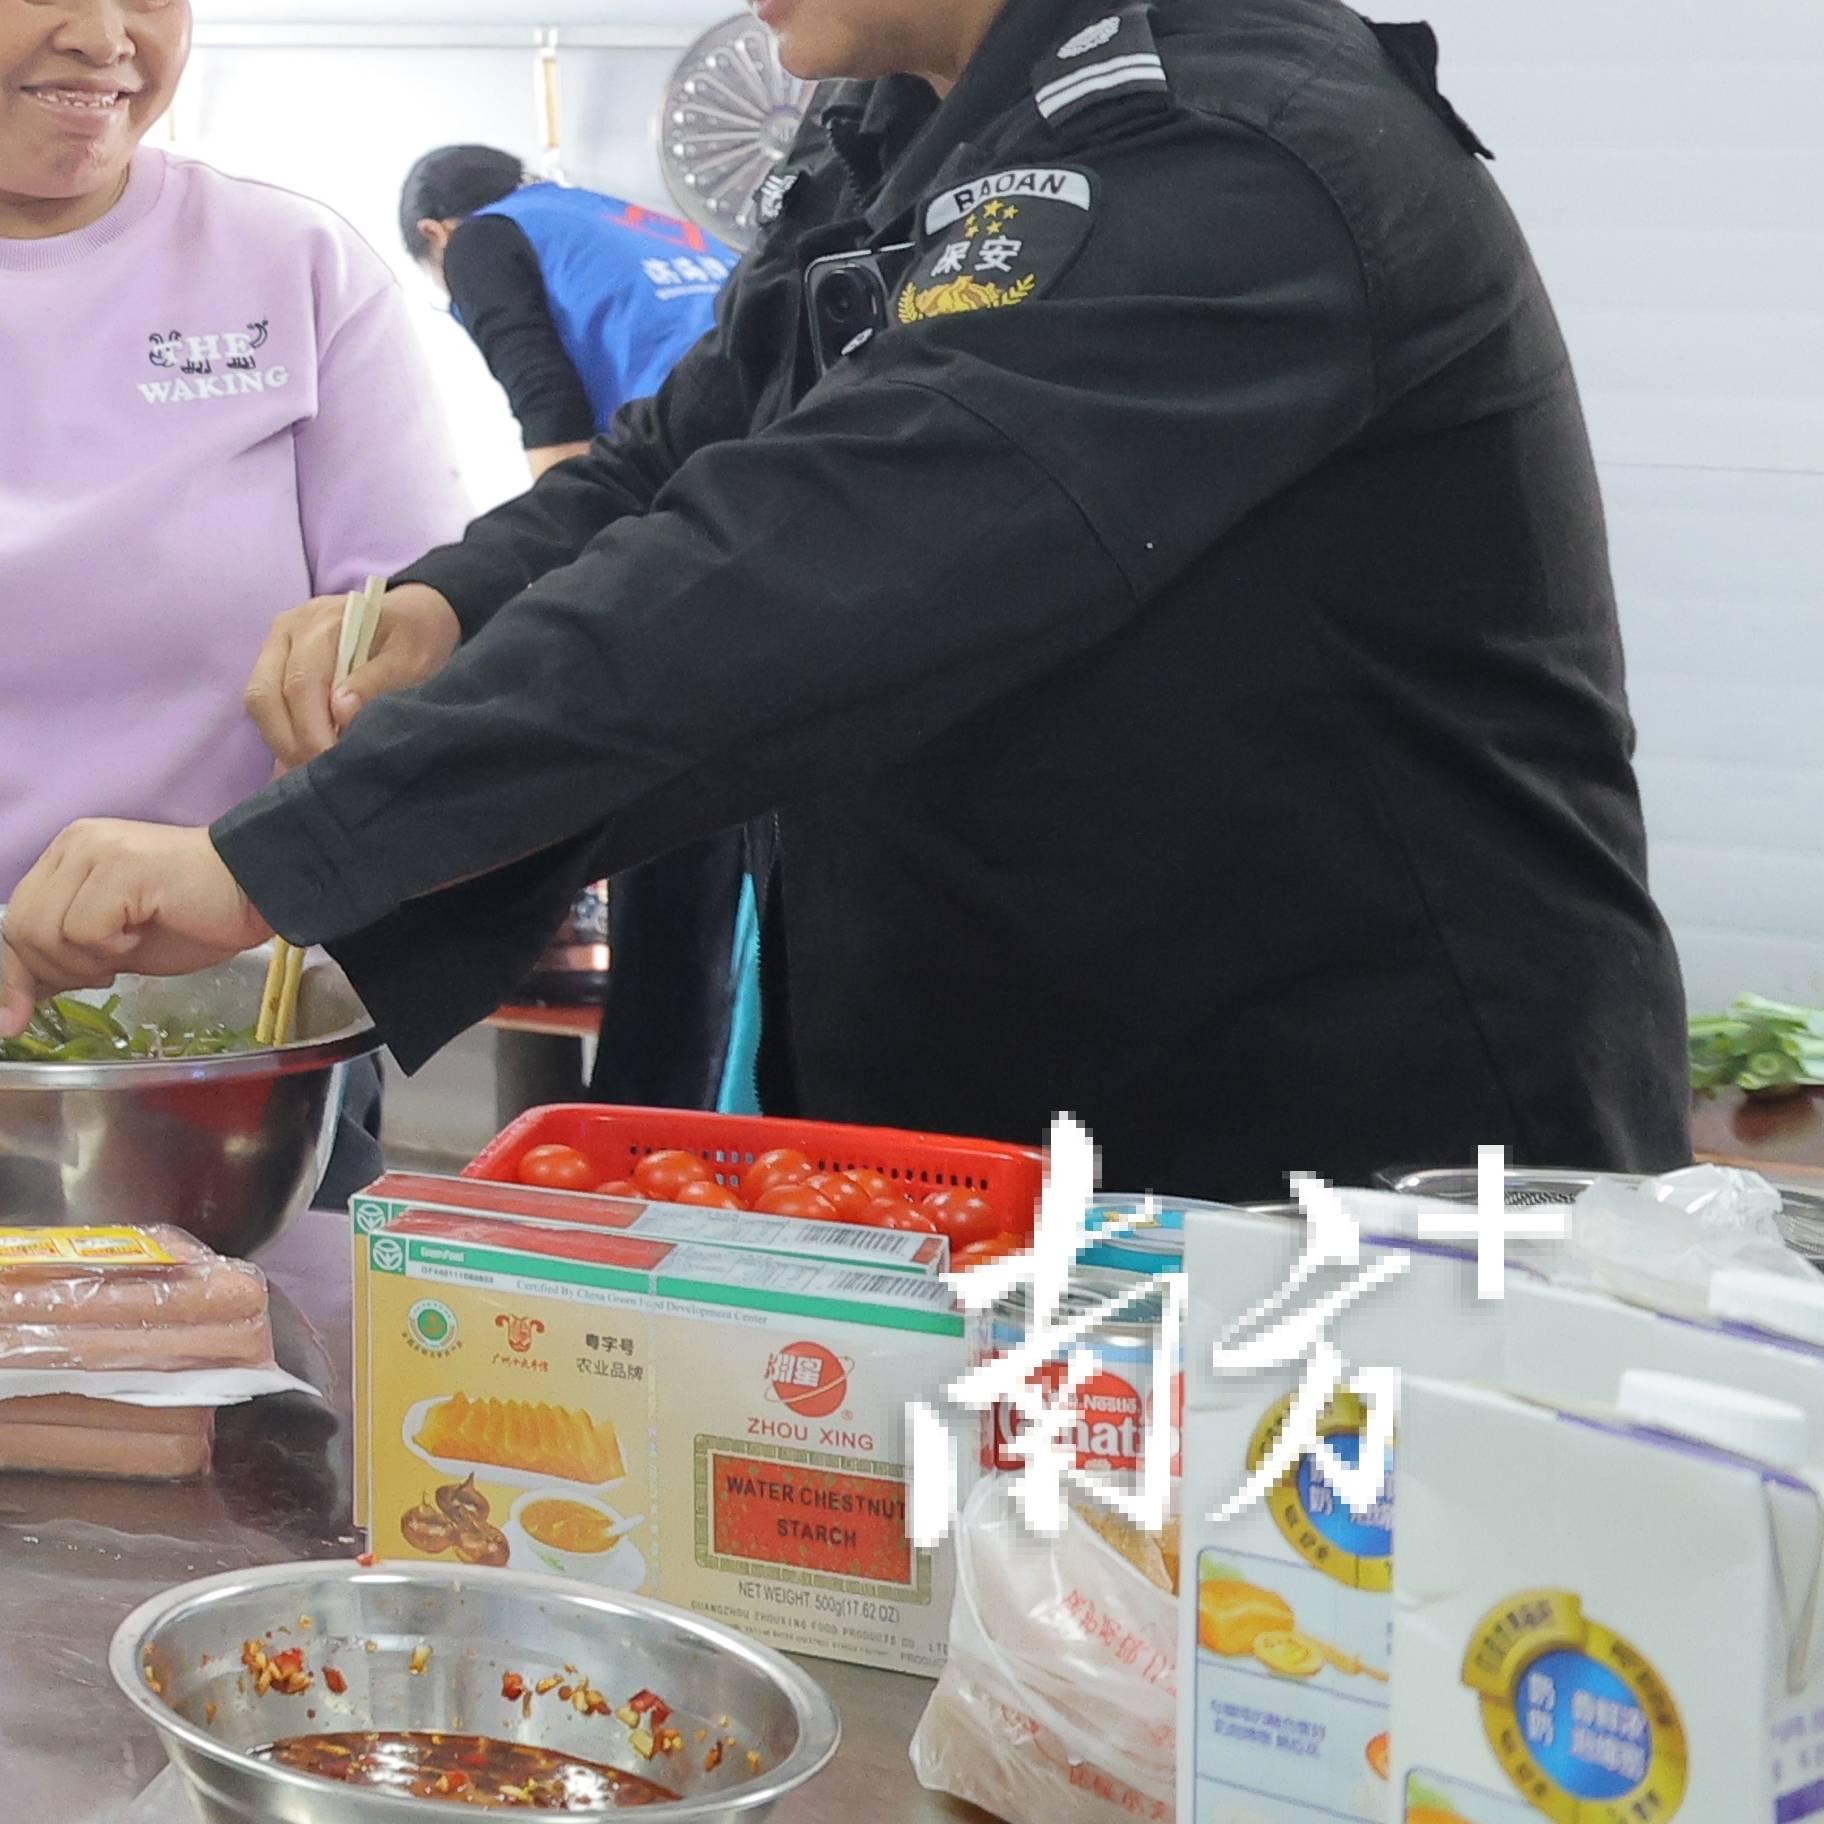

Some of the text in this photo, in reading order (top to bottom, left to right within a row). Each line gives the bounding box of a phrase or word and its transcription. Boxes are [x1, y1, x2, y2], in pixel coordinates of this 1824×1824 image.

[953, 172, 1068, 215] BAOAN
[930, 235, 1023, 276] 保安
[156, 332, 256, 364] THE
[136, 365, 289, 405] WAKING
[517, 1280, 560, 1295] Certified
[561, 1282, 575, 1299] By
[577, 1286, 605, 1303] China
[666, 1299, 731, 1323] Development
[734, 1308, 768, 1325] Center
[584, 1332, 636, 1357] 粤字号
[575, 1356, 645, 1382] 农业品牌
[746, 1417, 875, 1451] ZHOU XING
[726, 1475, 906, 1520] WATER CHESTNUT
[776, 1518, 857, 1548] STARCH
[738, 1580, 763, 1600] NET
[764, 1585, 811, 1607] WEIGHT
